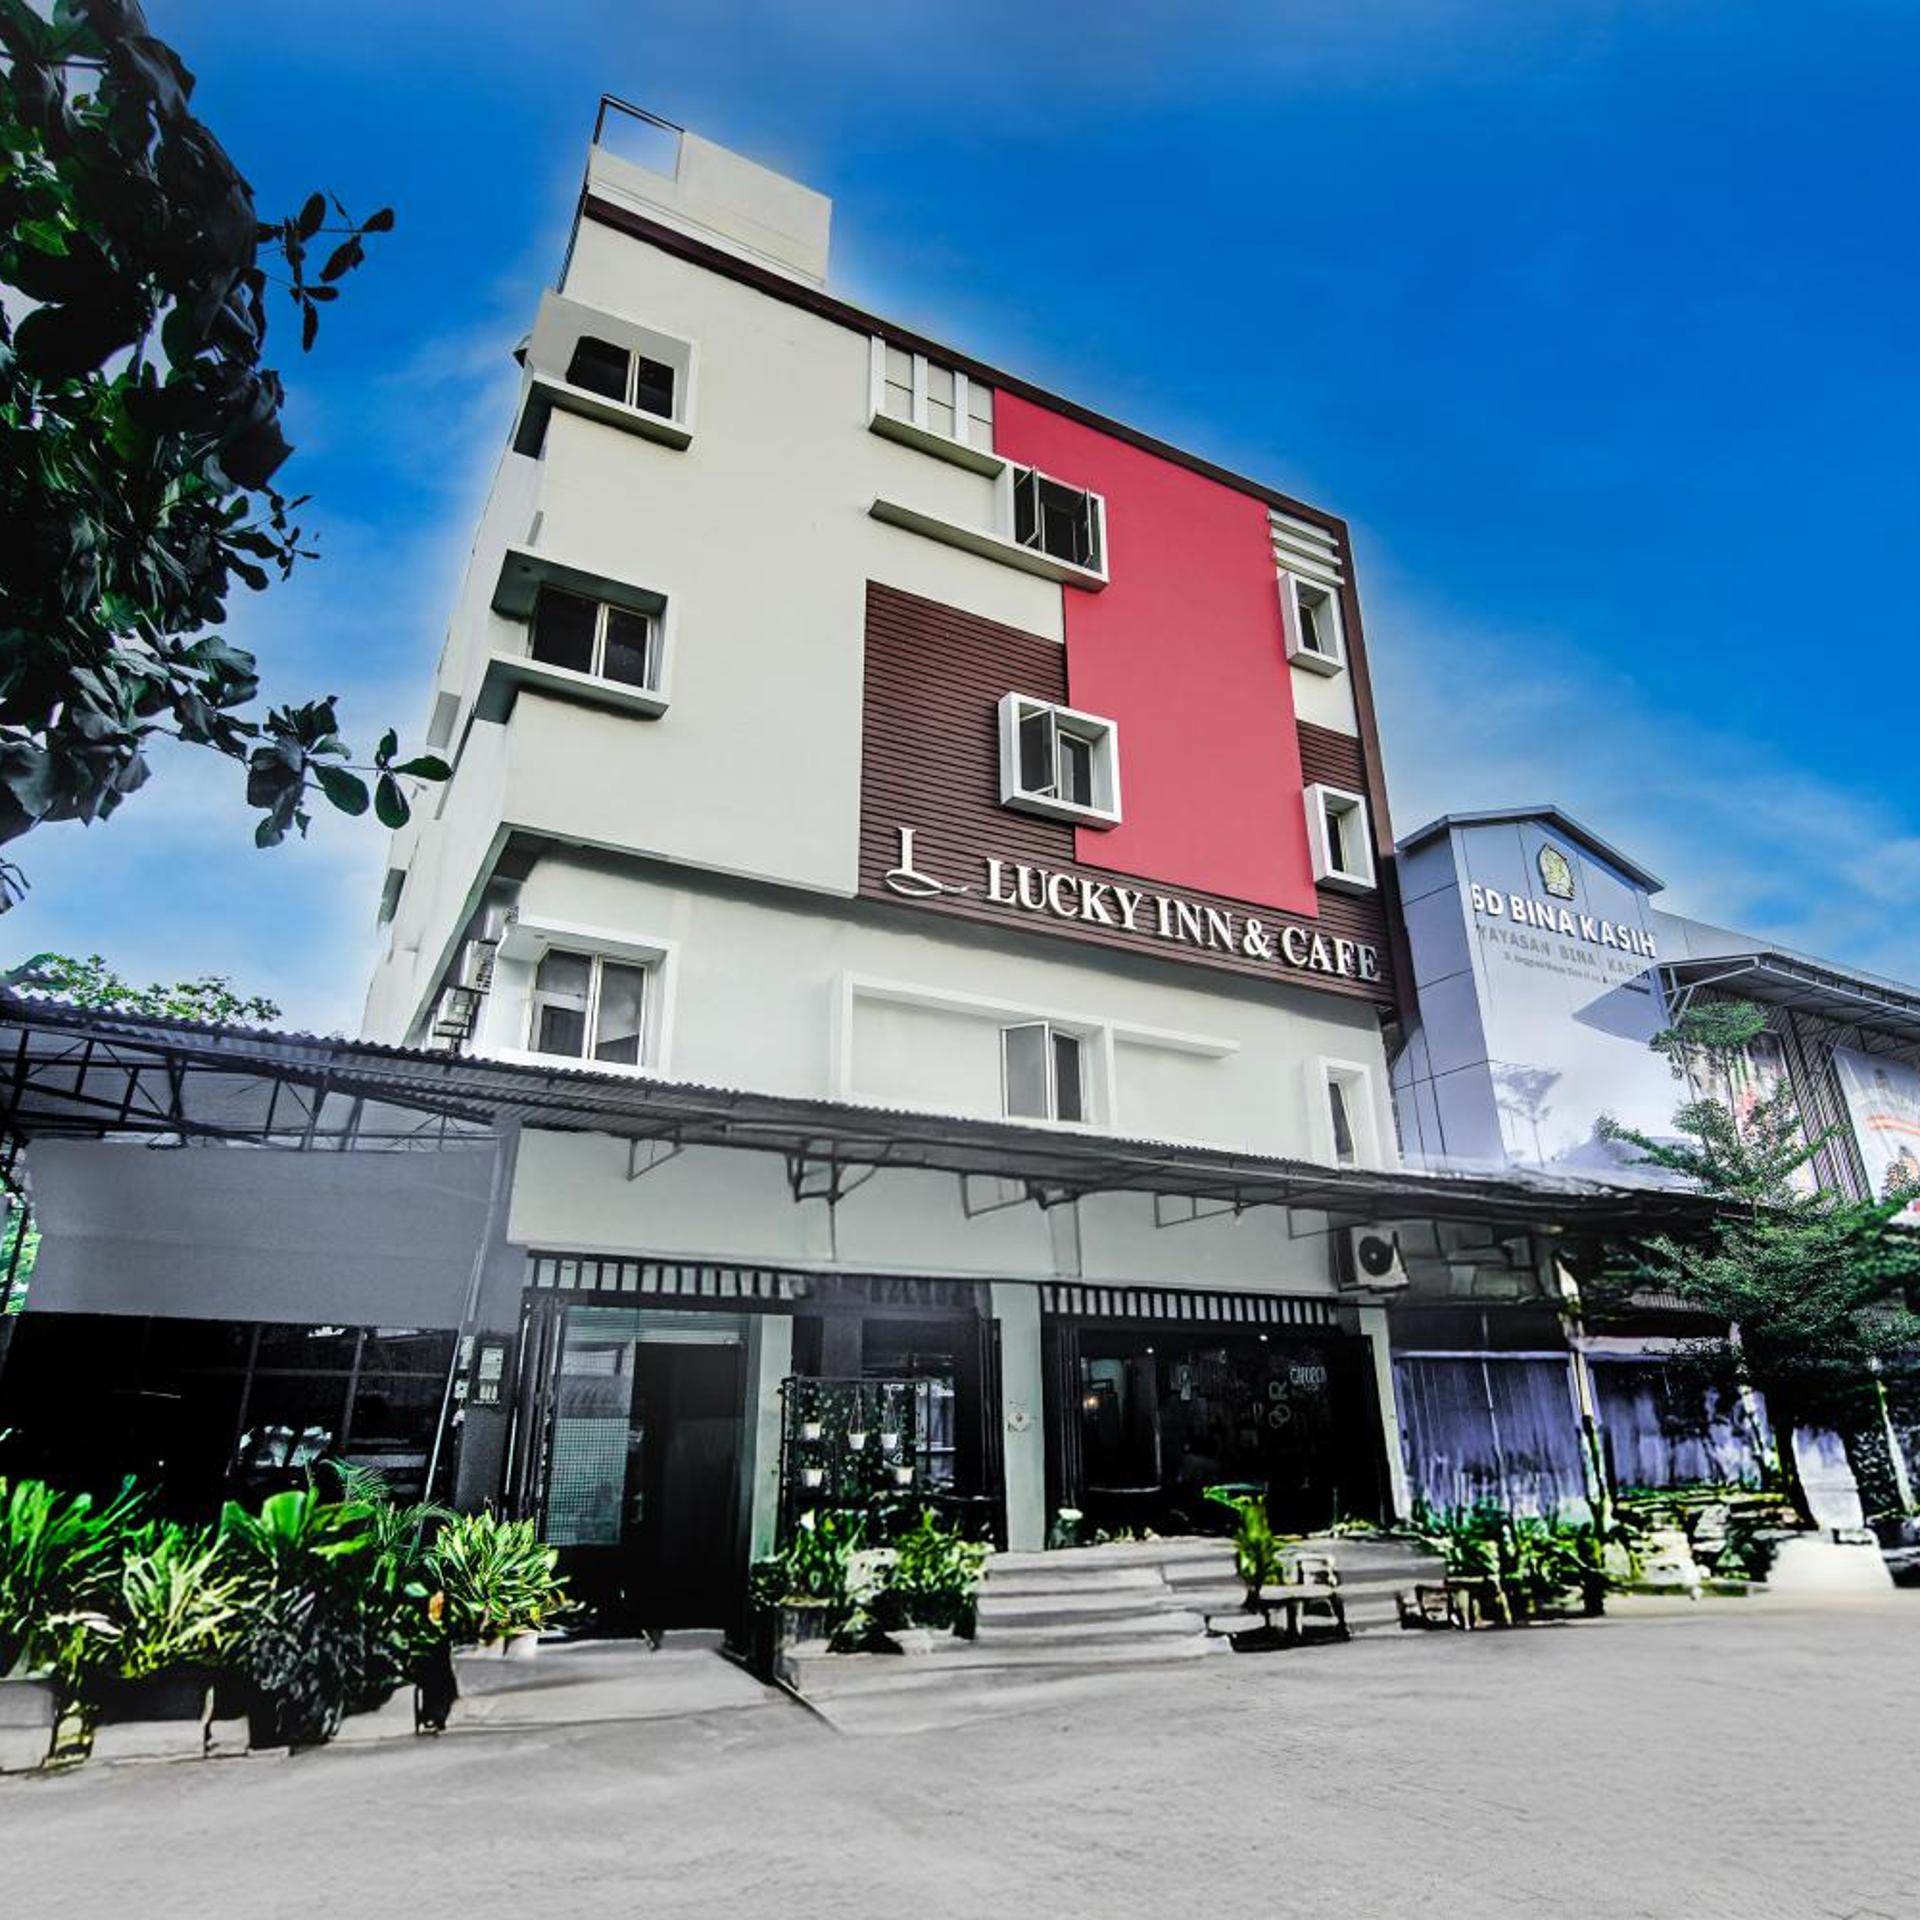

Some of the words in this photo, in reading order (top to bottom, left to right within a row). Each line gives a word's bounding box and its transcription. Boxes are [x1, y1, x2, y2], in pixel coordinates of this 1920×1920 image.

[986, 857, 1142, 930] LUCKY
[1156, 896, 1233, 951] INN
[1243, 919, 1272, 959] &
[1281, 926, 1381, 982] CAFE
[1471, 883, 1503, 915] SD
[1509, 894, 1575, 937] BINA
[1579, 914, 1656, 958] KASIH
[1479, 926, 1551, 956] YAYASAN
[1559, 945, 1597, 967] BINA
